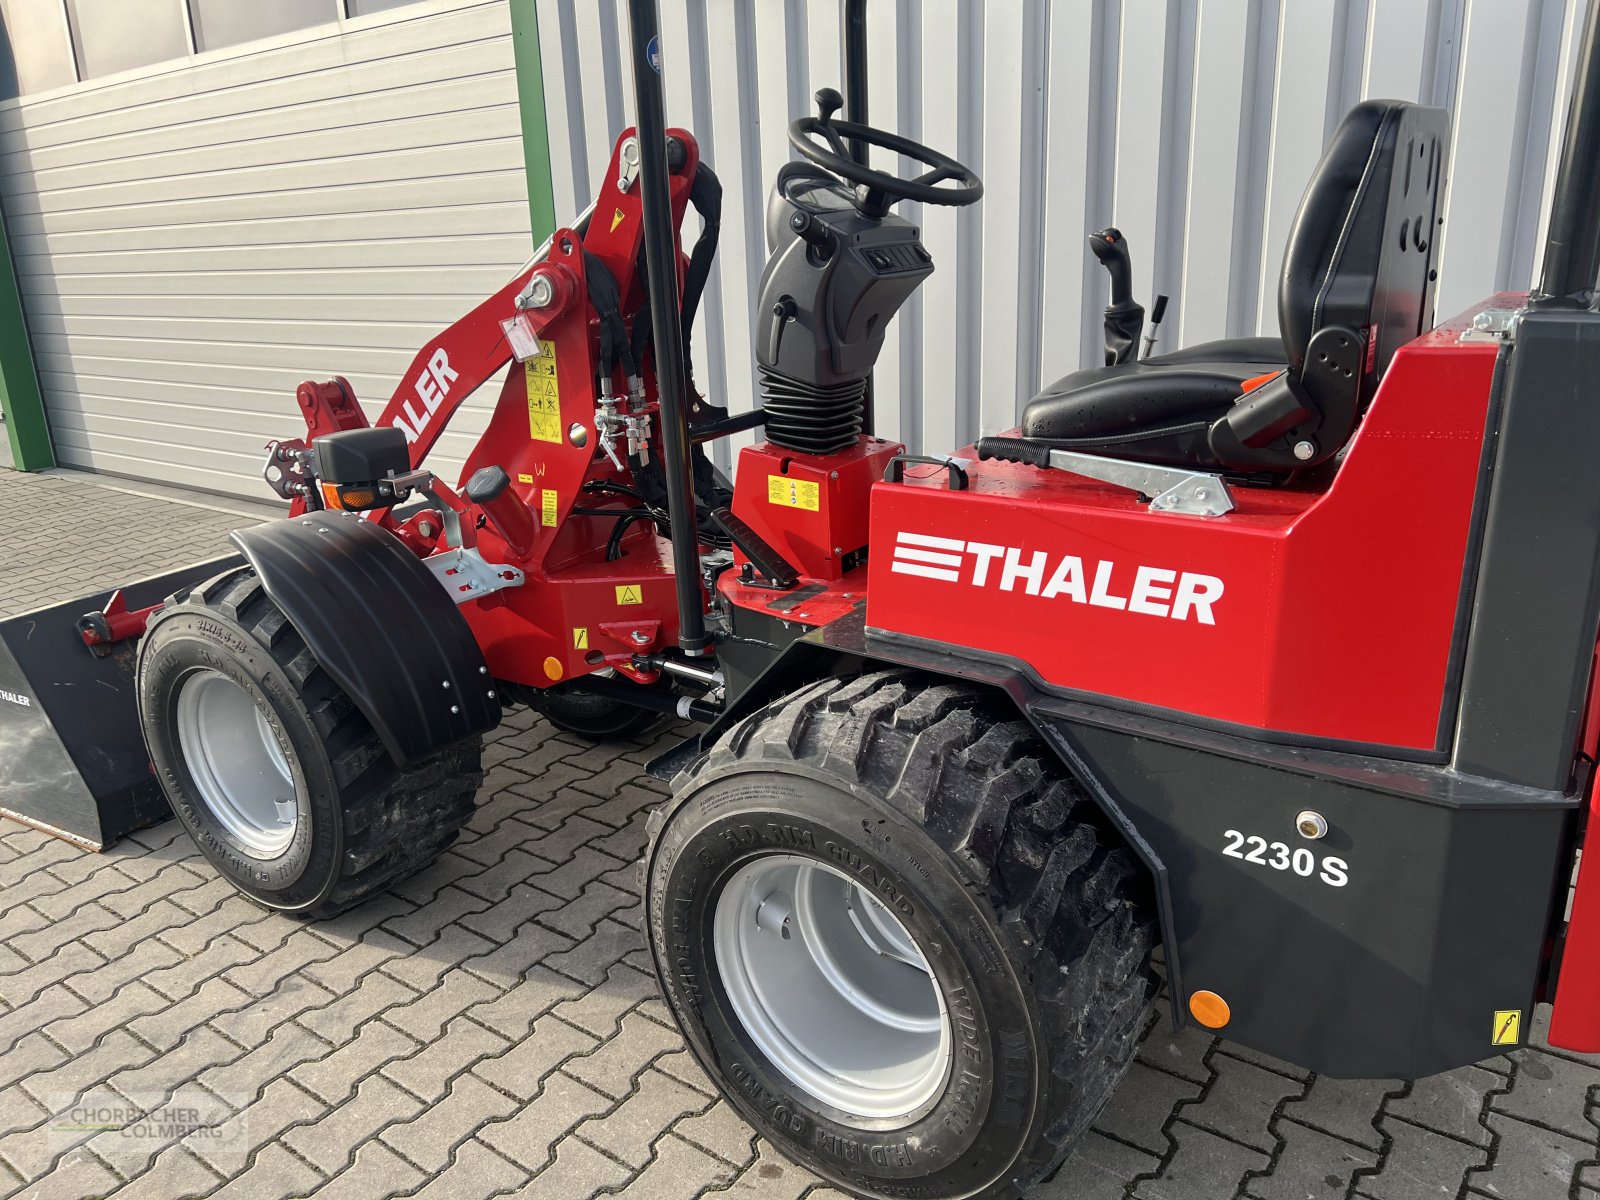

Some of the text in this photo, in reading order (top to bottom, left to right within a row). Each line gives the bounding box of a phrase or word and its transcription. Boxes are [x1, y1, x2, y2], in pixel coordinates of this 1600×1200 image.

[966, 541, 1225, 625] THALER
[825, 841, 915, 918] GUARD
[907, 855, 930, 879] NYLON
[1222, 829, 1349, 887] 2230 S
[950, 986, 982, 1063] WIDE
[729, 1061, 808, 1137] GUARD
